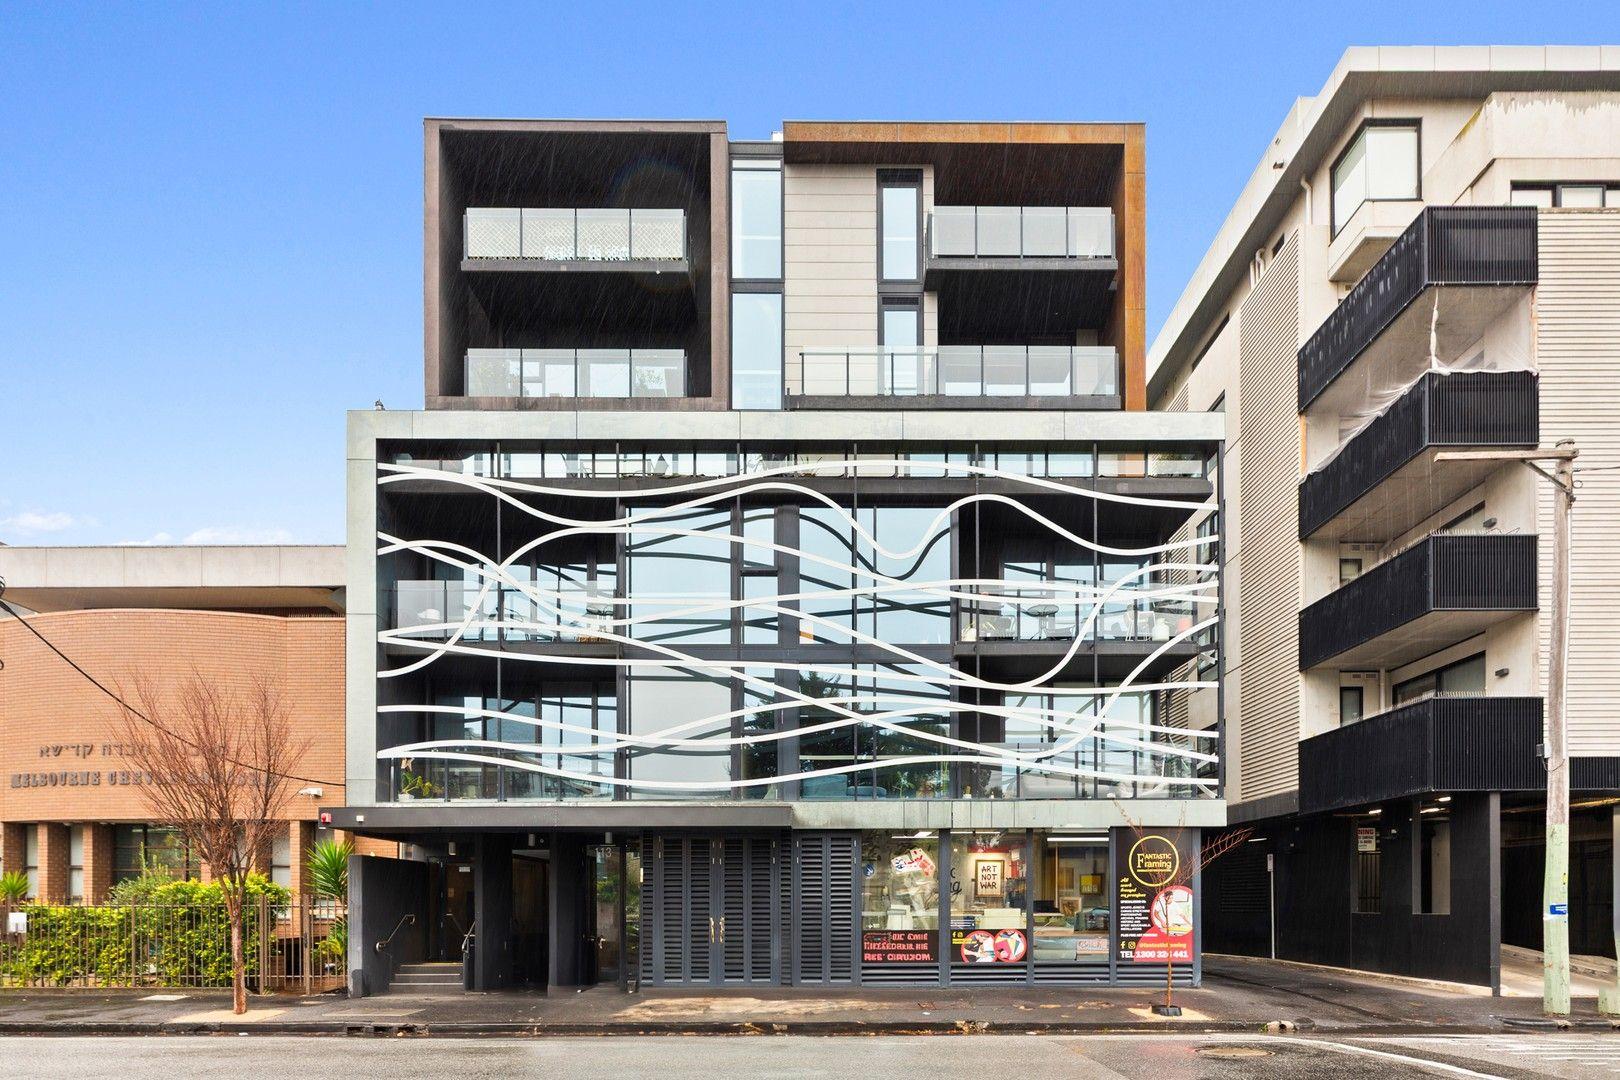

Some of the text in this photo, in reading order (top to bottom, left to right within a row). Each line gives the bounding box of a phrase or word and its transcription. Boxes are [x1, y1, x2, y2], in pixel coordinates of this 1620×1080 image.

[11, 771, 101, 788] MELBOURNE
[1137, 853, 1172, 861] FANTASTIC
[1137, 859, 1172, 869] Framing
[981, 865, 997, 873] ART
[981, 873, 997, 881] NOT
[980, 881, 997, 889] WAR
[1120, 950, 1134, 958] TEL
